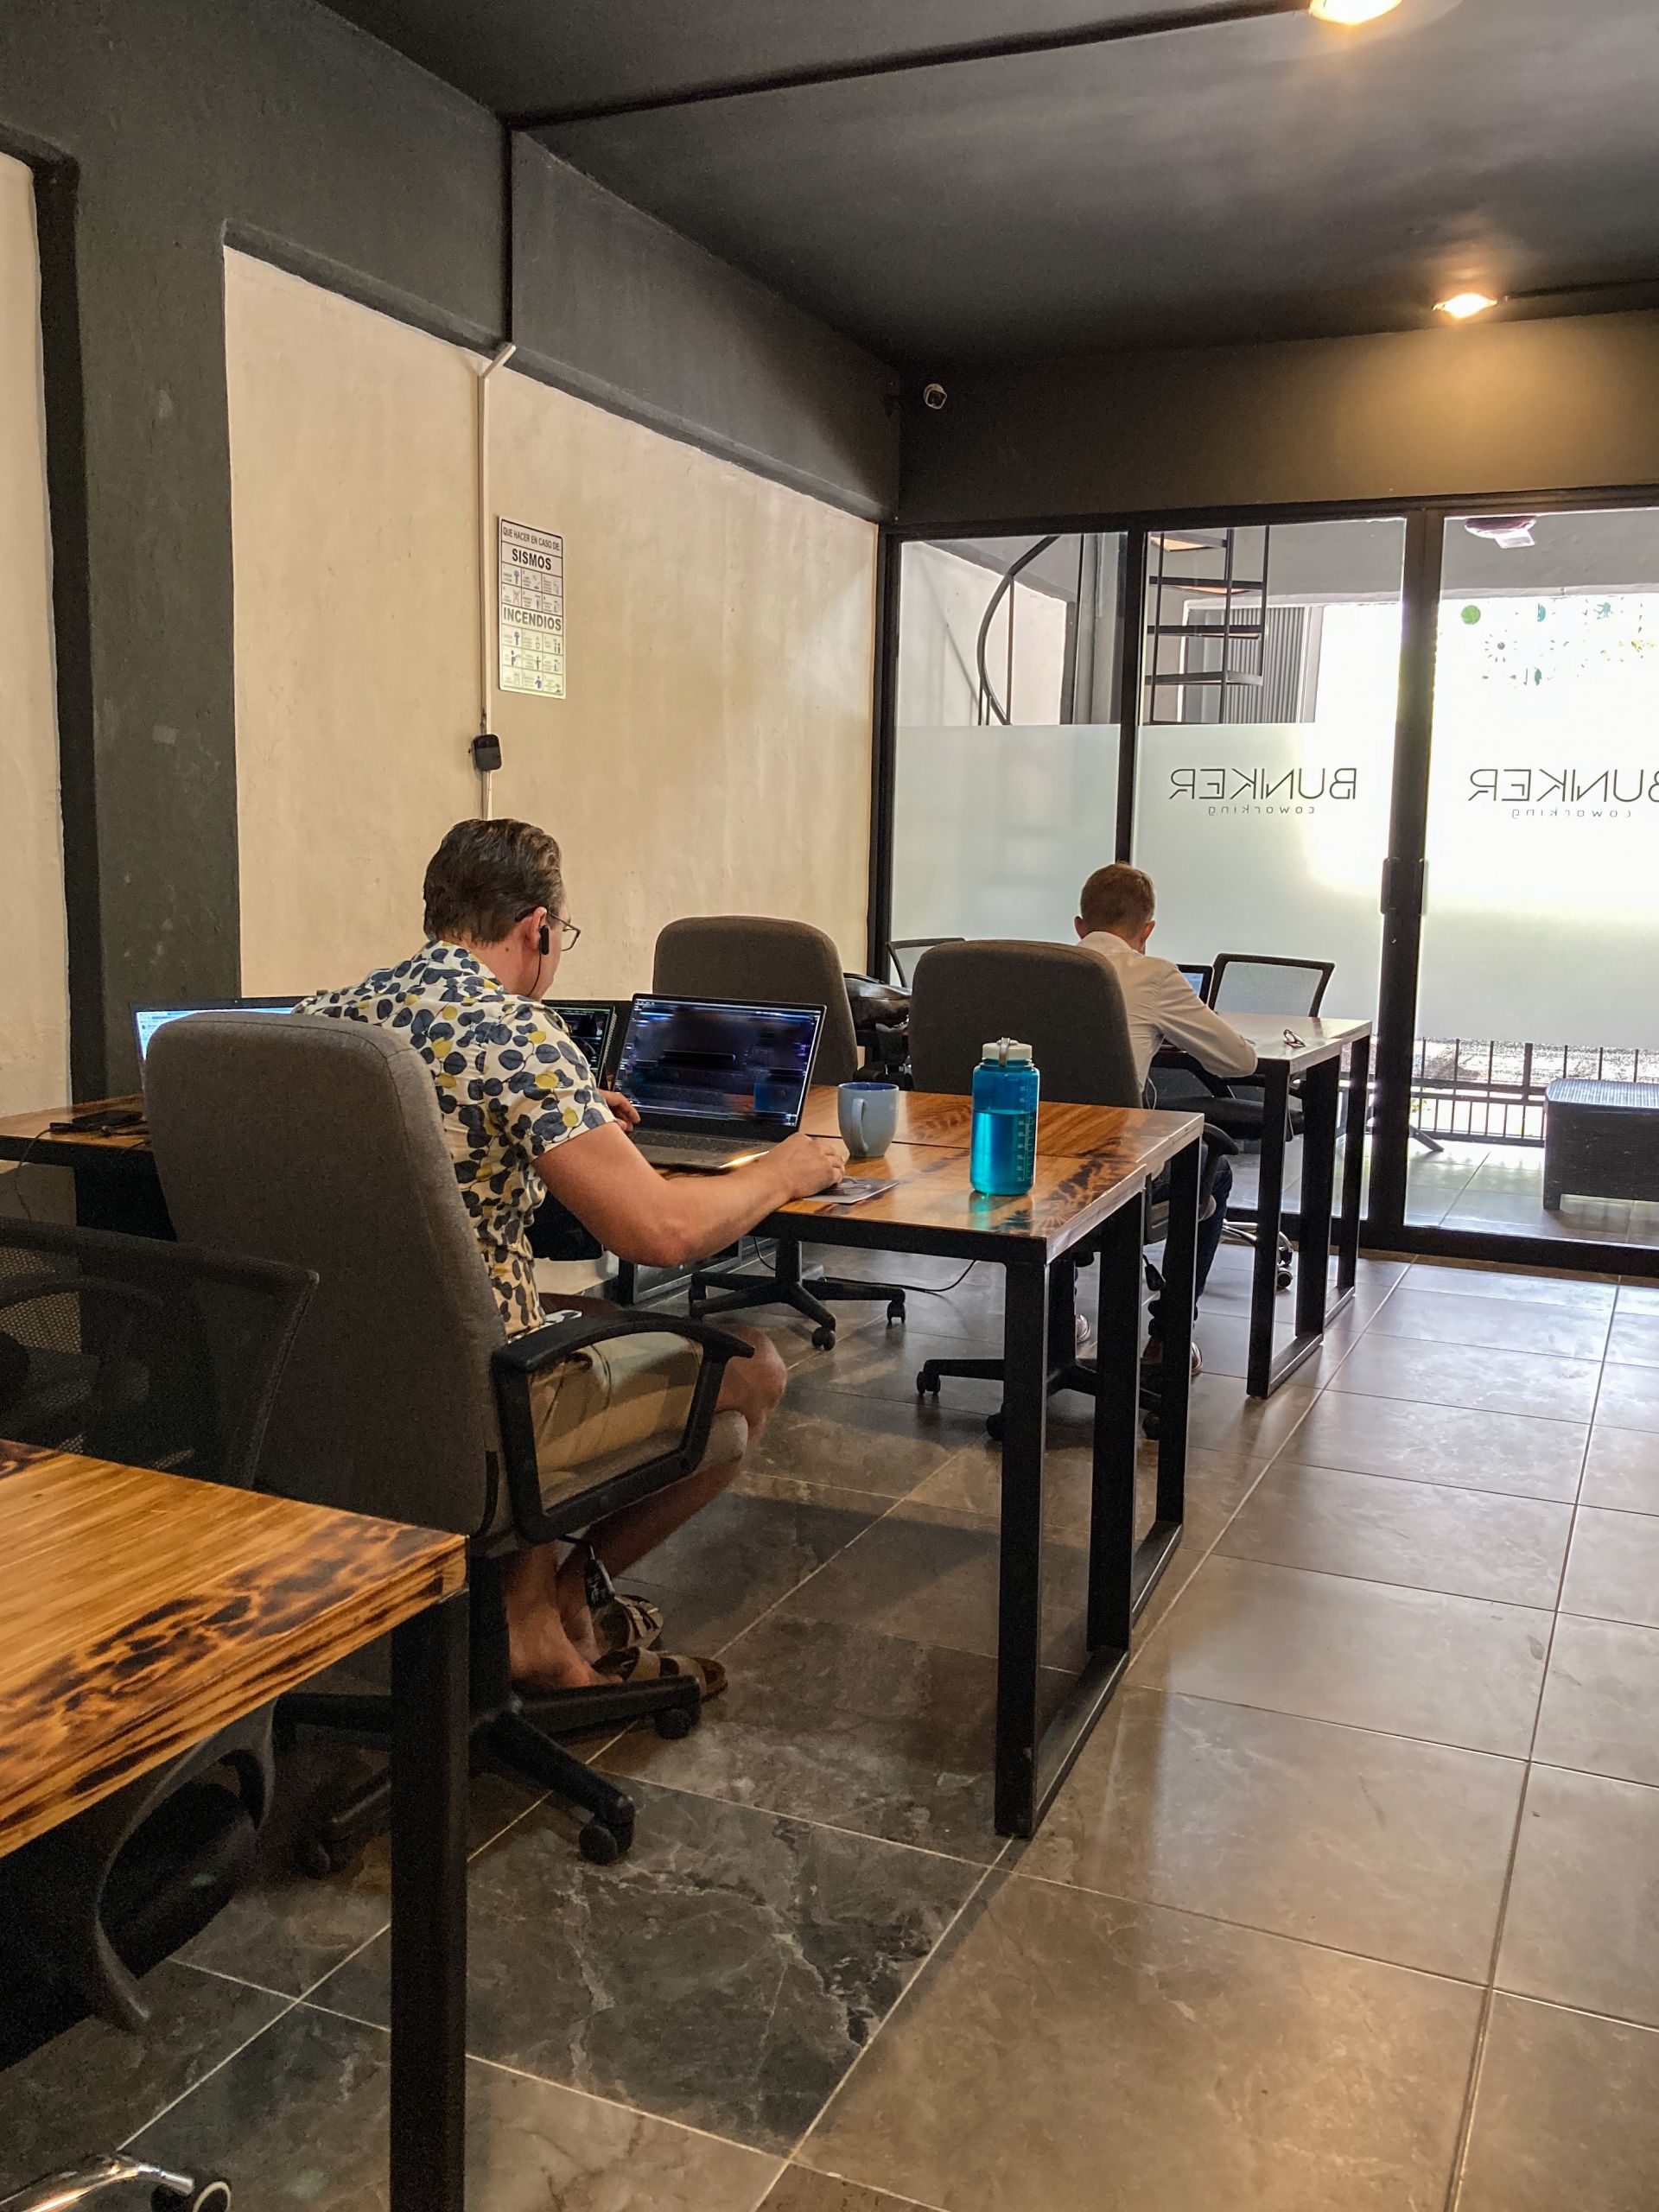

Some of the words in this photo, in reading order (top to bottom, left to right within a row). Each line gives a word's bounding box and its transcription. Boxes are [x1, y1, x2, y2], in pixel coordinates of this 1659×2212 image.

[503, 527, 512, 537] QUE
[513, 531, 530, 543] HACER
[531, 535, 537, 544] EN
[538, 537, 551, 549] CASO
[512, 548, 551, 570] SISMOS
[503, 607, 562, 632] INCENDIOS
